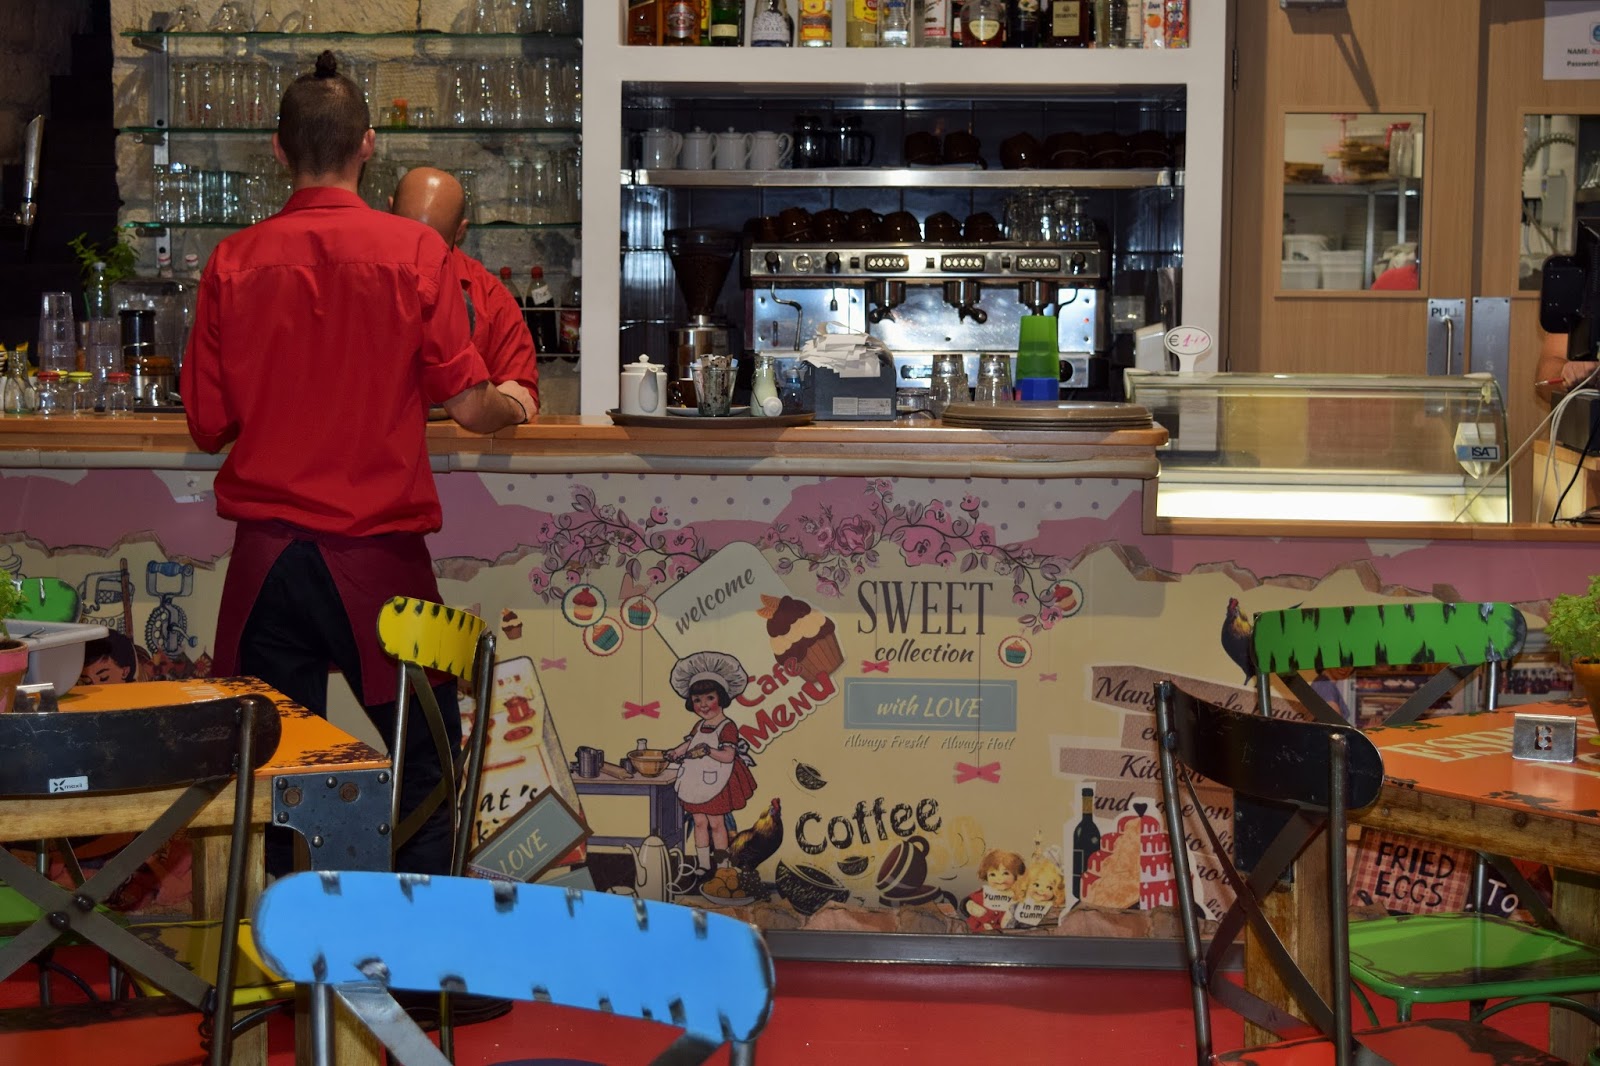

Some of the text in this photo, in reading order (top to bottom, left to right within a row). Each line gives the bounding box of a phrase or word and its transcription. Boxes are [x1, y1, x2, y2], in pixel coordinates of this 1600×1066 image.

[1471, 447, 1490, 457] ISA
[675, 568, 756, 635] welcome
[857, 580, 994, 635] SWEET
[874, 638, 975, 663] collection
[735, 657, 804, 707] Cafe
[876, 694, 984, 718] with LOVE
[844, 733, 1016, 754] Always Fresh! Always Hot!
[500, 828, 548, 877] LOVE
[1375, 841, 1455, 879] FRIED
[984, 892, 1012, 903] yummy
[1374, 870, 1444, 907] EGGS
[1022, 903, 1046, 912] in my
